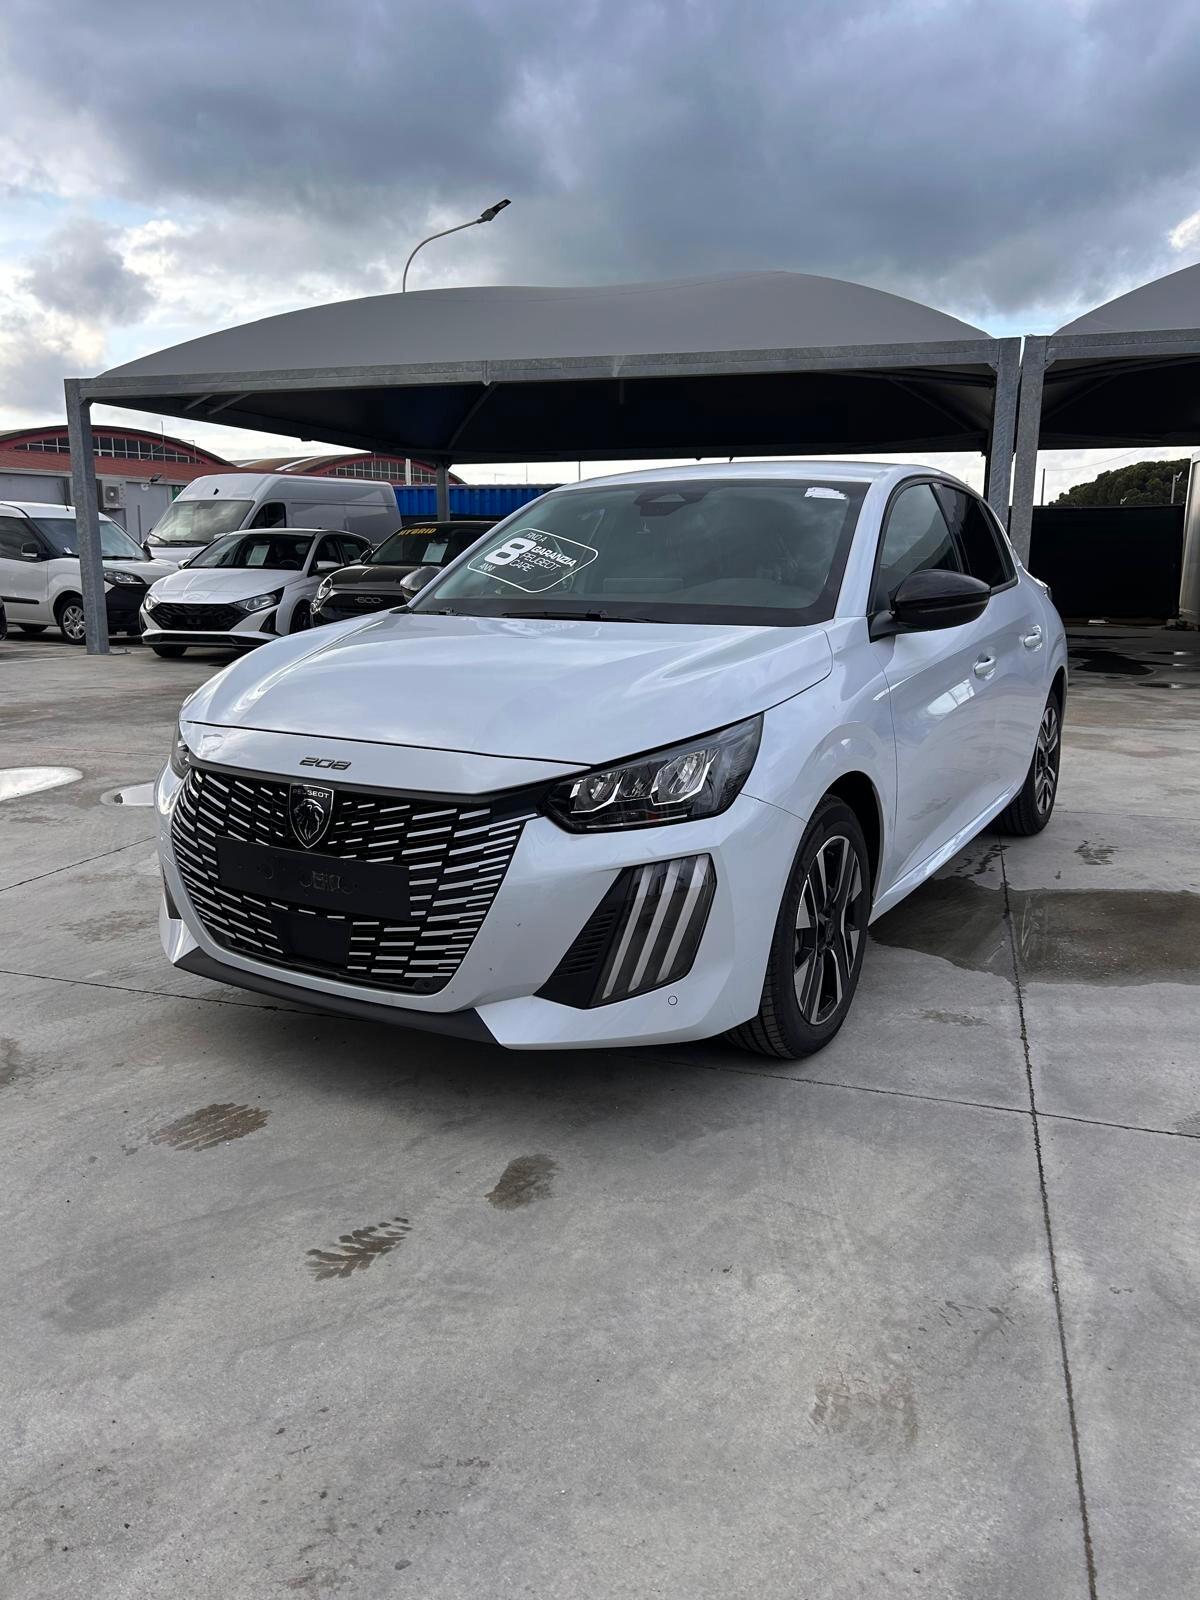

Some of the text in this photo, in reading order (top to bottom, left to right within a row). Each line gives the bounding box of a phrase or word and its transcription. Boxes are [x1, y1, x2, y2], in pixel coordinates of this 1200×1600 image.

[398, 527, 437, 536] HYBRID
[484, 537, 537, 566] 8
[530, 546, 578, 567] GARANZIA
[509, 559, 535, 572] CARE
[519, 552, 562, 572] PEUGEOT
[299, 757, 352, 771] 208
